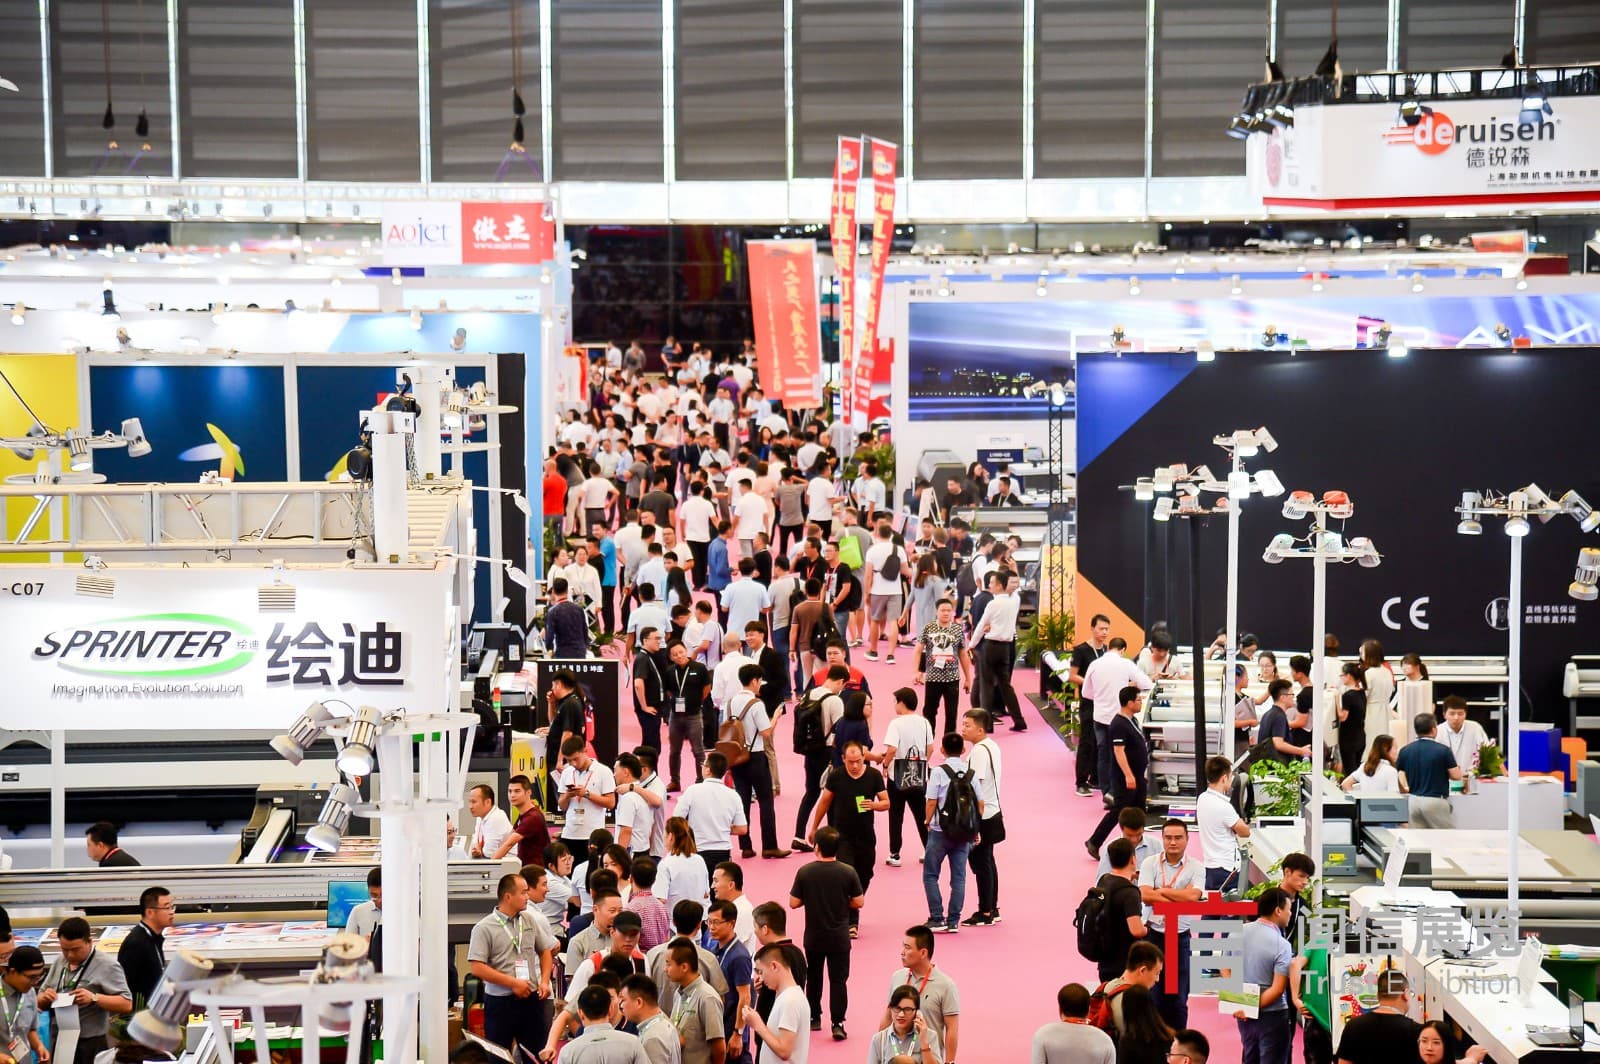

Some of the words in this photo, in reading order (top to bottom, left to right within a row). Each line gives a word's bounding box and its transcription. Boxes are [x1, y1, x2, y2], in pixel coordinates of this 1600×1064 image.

[1414, 115, 1555, 145] deruisen
[1466, 146, 1530, 168] 德锐森
[1381, 597, 1430, 630] CE
[35, 630, 231, 658] SPRINTER
[237, 639, 259, 648] 绘迪
[266, 622, 404, 685] 绘迪
